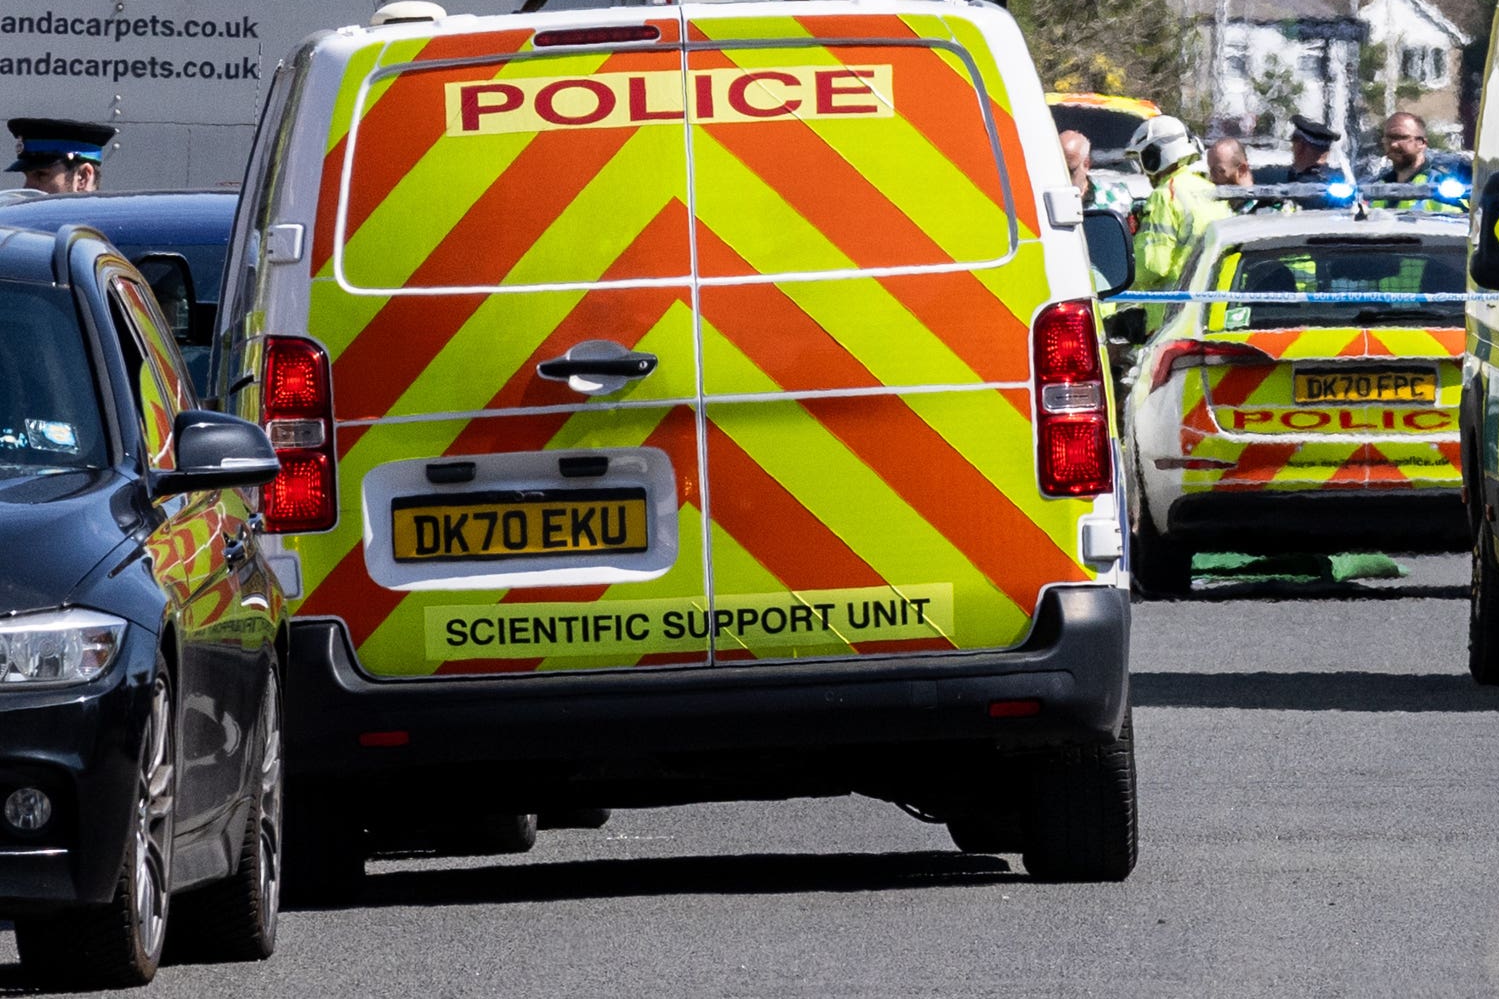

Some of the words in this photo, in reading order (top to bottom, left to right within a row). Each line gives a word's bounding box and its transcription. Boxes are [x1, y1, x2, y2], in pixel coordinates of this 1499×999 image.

[460, 69, 878, 132] POLICE
[1307, 377, 1371, 399] DK70
[1378, 376, 1425, 398] FPC
[1233, 410, 1452, 431] POLIC
[413, 510, 528, 556] DK70
[542, 506, 627, 549] EKU
[446, 614, 650, 646] SCIENTIFIC
[663, 604, 835, 640] SUPPORT
[847, 599, 931, 629] UNIT
